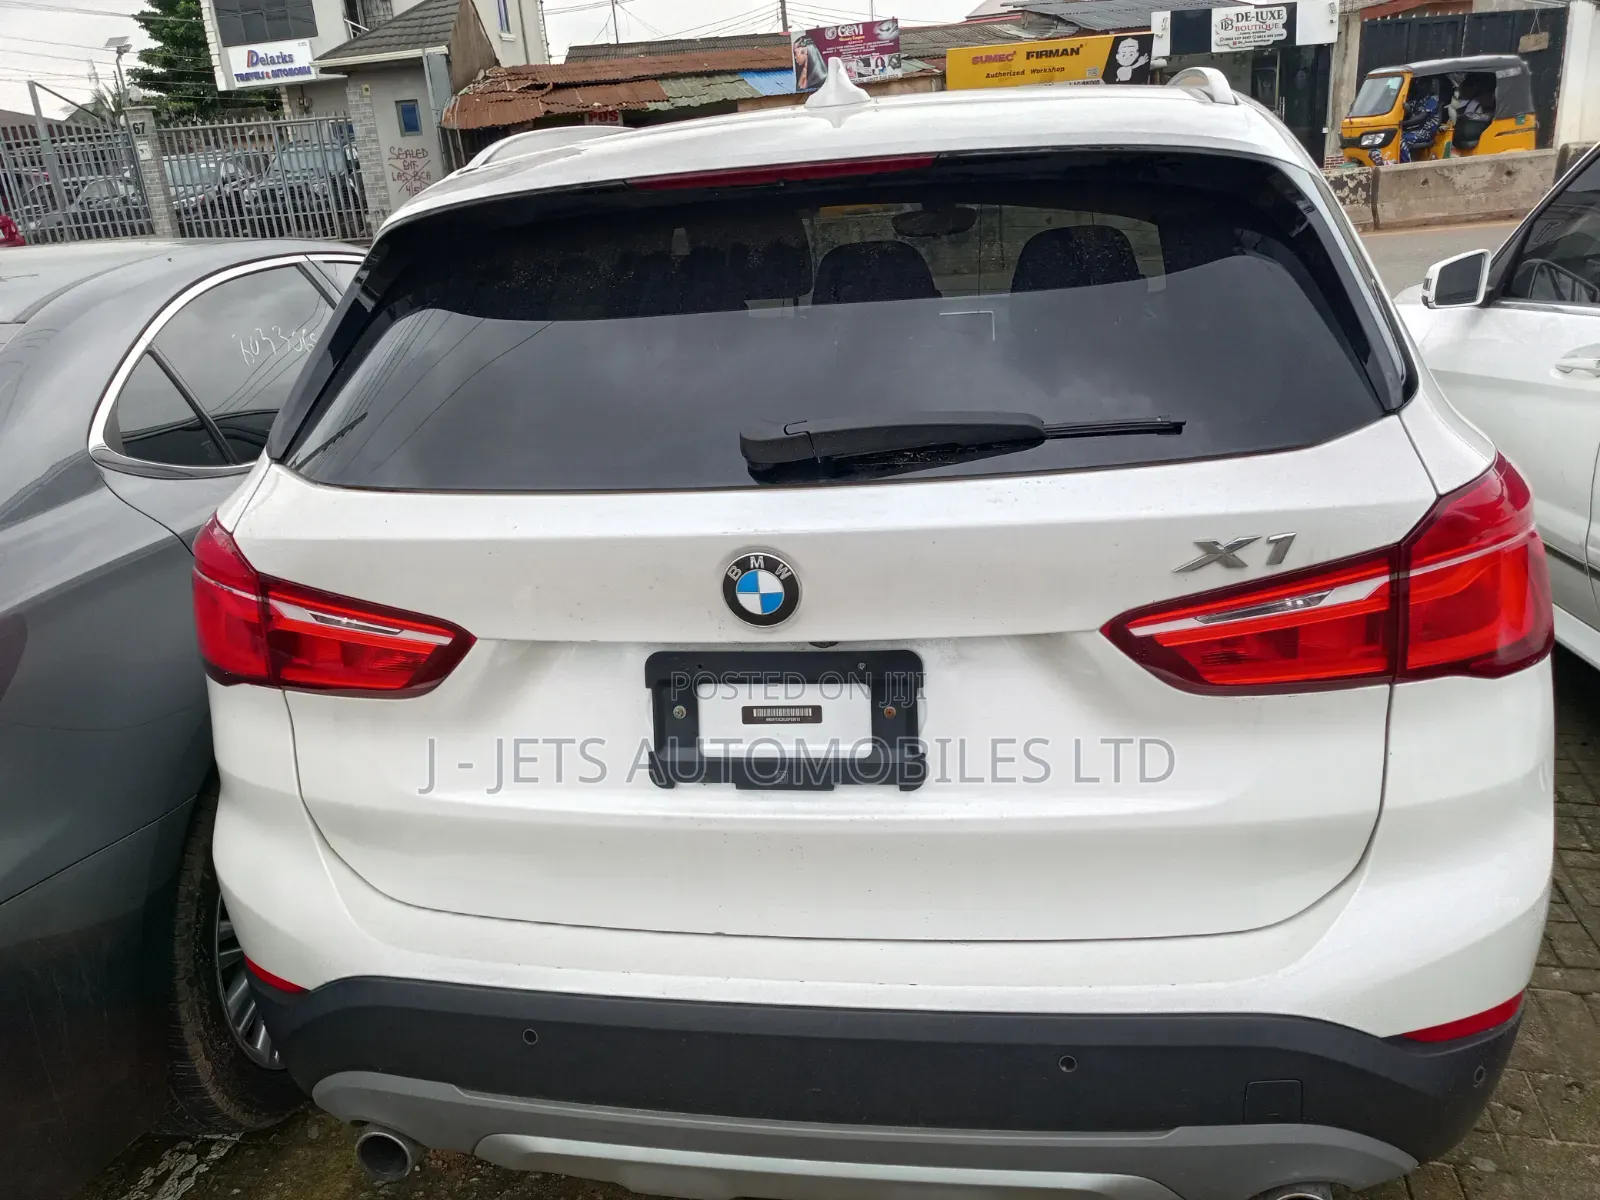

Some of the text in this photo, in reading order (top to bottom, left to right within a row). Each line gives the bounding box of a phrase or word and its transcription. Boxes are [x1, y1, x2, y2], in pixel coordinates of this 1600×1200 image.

[1235, 9, 1284, 24] DE-LUXE
[1235, 23, 1280, 32] BOUTIQUE
[247, 49, 294, 68] Delarks
[972, 47, 1081, 66] SUMEC FIRMAN
[985, 66, 1065, 79] Authorized Workshop
[588, 110, 619, 122] POS
[132, 121, 146, 135] 67
[388, 146, 429, 161] SEALED
[1172, 532, 1297, 573] X1
[727, 555, 793, 581] BMW
